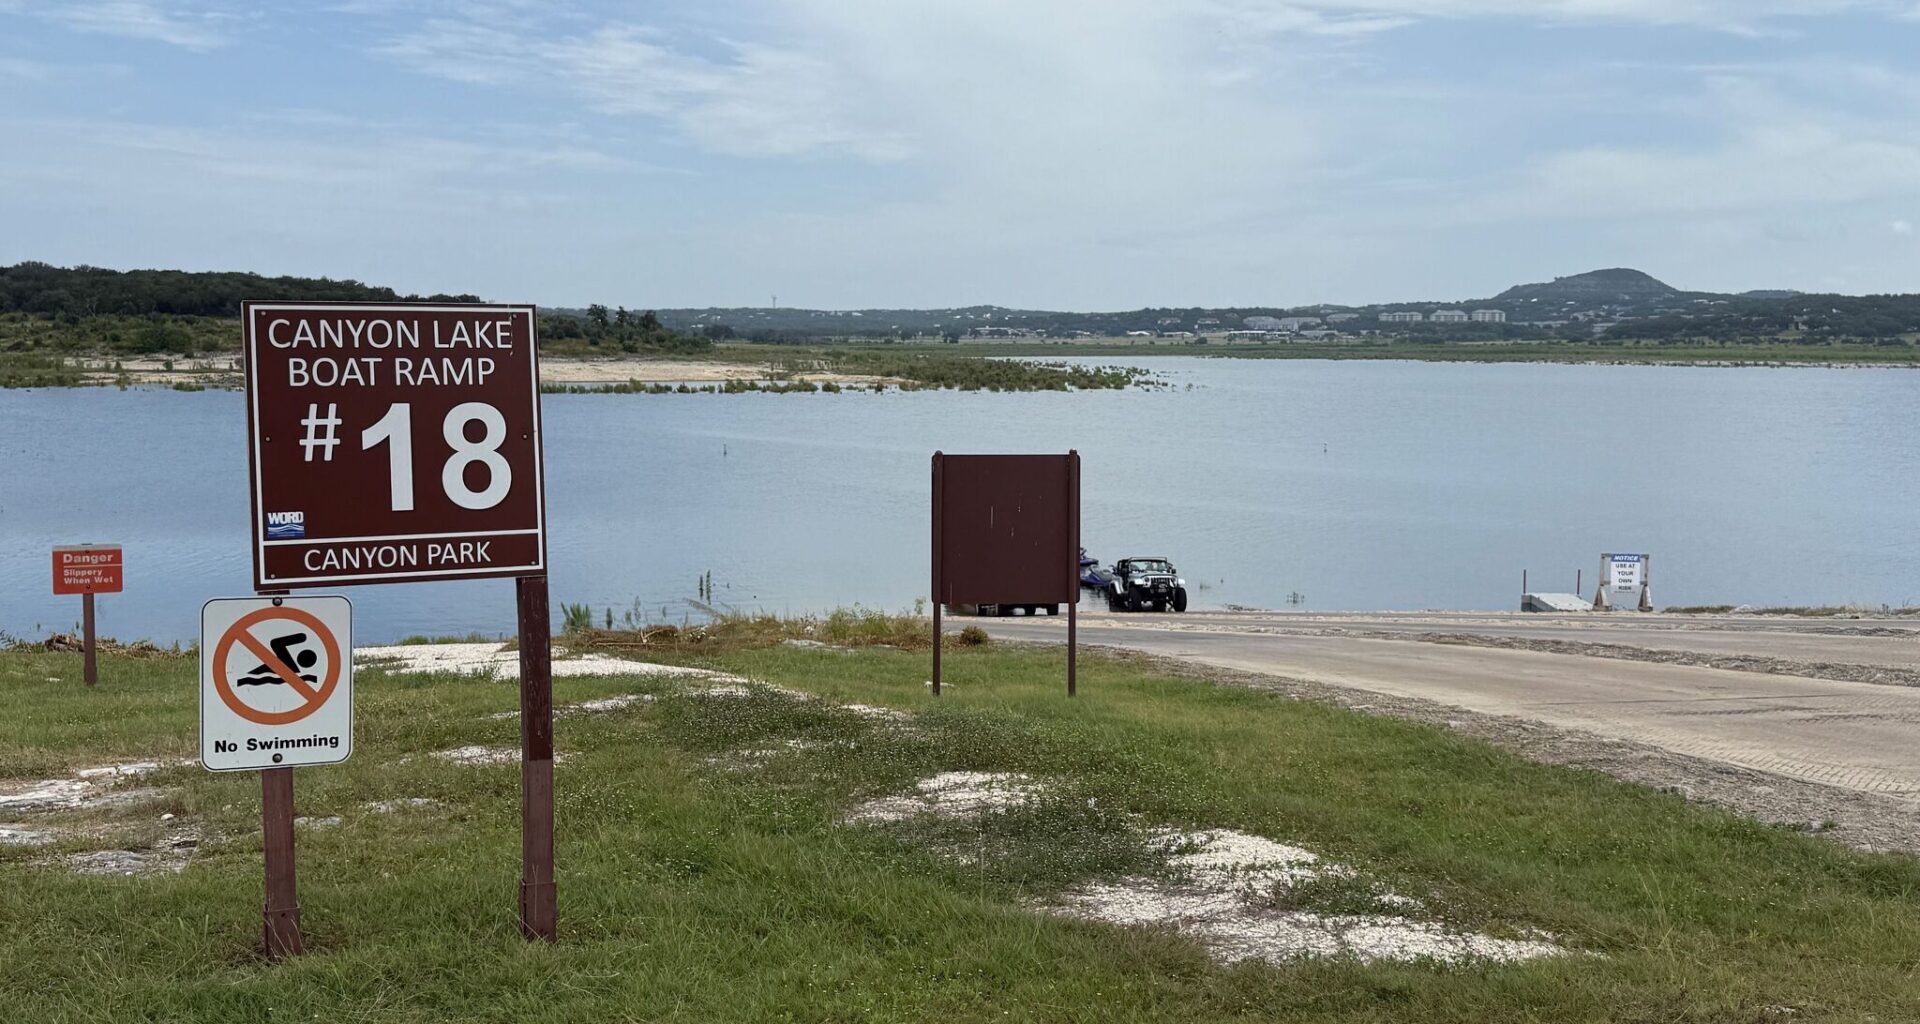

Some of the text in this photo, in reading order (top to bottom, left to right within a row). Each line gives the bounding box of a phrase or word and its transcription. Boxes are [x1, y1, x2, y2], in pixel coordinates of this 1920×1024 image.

[268, 318, 513, 349] CANYON LAKE
[288, 357, 495, 387] BOAT RAMP
[299, 402, 512, 511] #18
[268, 511, 304, 525] WORD
[63, 554, 113, 564] Danger
[304, 541, 492, 571] CANYON PARK
[63, 569, 103, 577] Slippery
[214, 734, 339, 753] No Swimming
